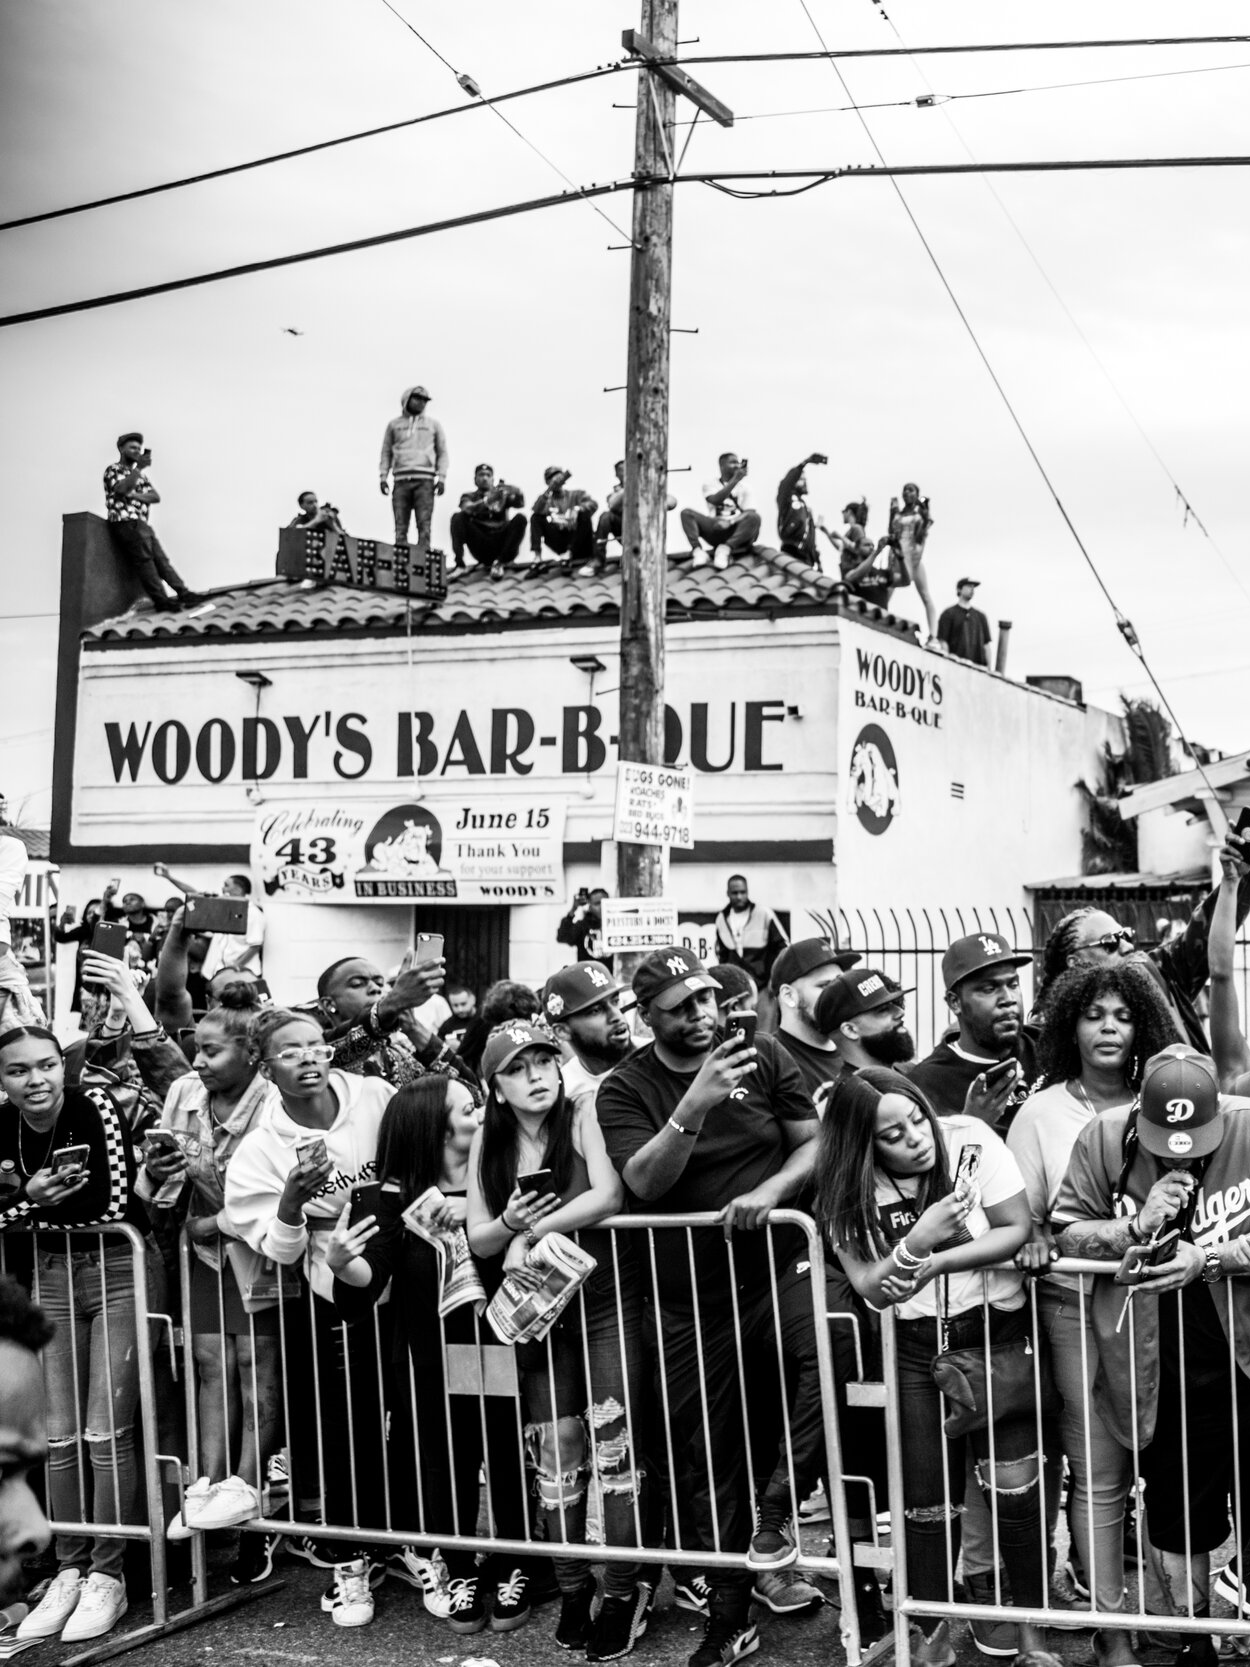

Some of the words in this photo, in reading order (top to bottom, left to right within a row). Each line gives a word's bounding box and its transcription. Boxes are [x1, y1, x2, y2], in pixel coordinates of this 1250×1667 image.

[856, 648, 943, 705] WOODY'S
[855, 690, 943, 730] BAR-B-QUE
[104, 711, 373, 785] WOODY'S
[260, 808, 365, 845] Celebrating
[456, 807, 518, 830] June
[525, 807, 551, 829] 15
[634, 821, 690, 844] 944-9718
[275, 837, 337, 866] 43
[456, 843, 506, 858] Thank
[511, 842, 541, 858] You
[279, 867, 332, 889] YEARS
[460, 863, 475, 875] for
[477, 866, 504, 878] your
[506, 864, 553, 879] support
[356, 881, 373, 896] IN
[376, 881, 456, 896] BUSINESS
[480, 885, 556, 897] WOODY'S
[978, 936, 1003, 956] LA
[583, 966, 609, 988] LA
[666, 956, 690, 976] NY
[506, 1028, 533, 1045] LA
[1165, 1098, 1195, 1123] D
